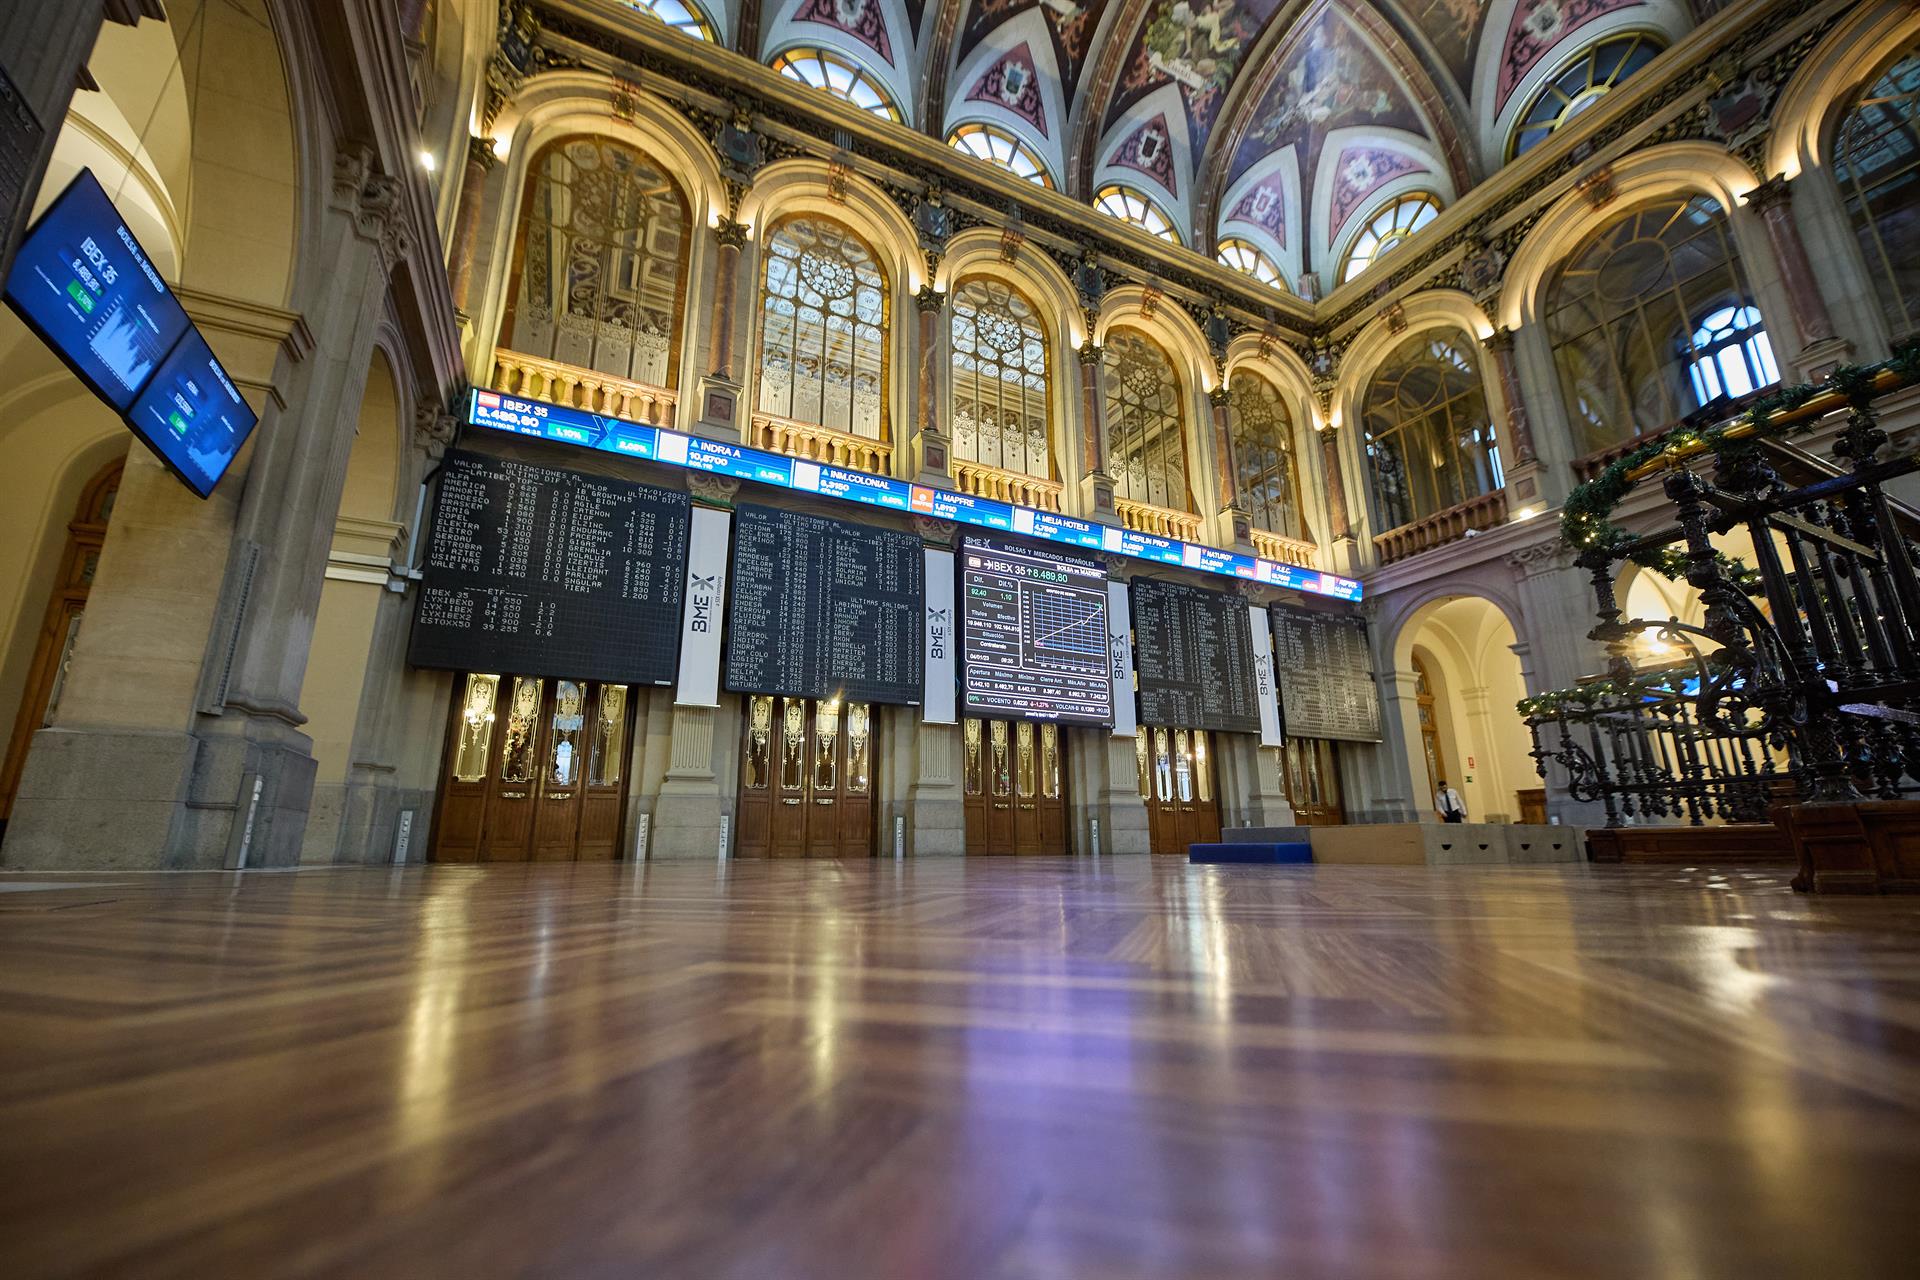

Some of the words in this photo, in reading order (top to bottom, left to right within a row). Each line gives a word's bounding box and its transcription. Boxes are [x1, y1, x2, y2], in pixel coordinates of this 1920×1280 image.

[80, 236, 108, 272] IBEX
[102, 265, 118, 285] 35
[504, 400, 531, 414] IBEX
[534, 406, 548, 417] 35
[477, 406, 539, 427] 8.489,80
[701, 442, 731, 456] INDRA
[733, 449, 741, 458] A
[445, 471, 469, 481] ALFA
[453, 459, 483, 470] VALOR
[506, 469, 539, 480] ULTIMO
[544, 476, 560, 484] DIF
[444, 478, 485, 490] AMERICA
[501, 461, 567, 478] COTIZACIONES
[638, 487, 686, 500] 04/01/2023
[831, 470, 890, 490] INM.COLONIAL
[443, 484, 484, 497] BANORTE
[582, 483, 607, 492] VALOR
[628, 491, 657, 501] ULTIMO
[442, 491, 489, 504] BRADESCO
[596, 498, 616, 506] BION
[943, 494, 975, 508] MAPFRE
[441, 498, 482, 510] BRASKEM
[574, 500, 600, 510] AGILE
[440, 505, 470, 515] CEMIG
[574, 506, 610, 518] CATENON
[438, 511, 469, 522] COPEL
[573, 513, 594, 521] EIDF
[745, 512, 767, 520] VALOR
[437, 518, 479, 530] ELEKTRA
[572, 519, 603, 529] ELZINC
[1042, 515, 1062, 526] MELIA
[1063, 520, 1089, 532] HOTELS
[436, 525, 472, 536] ELETRO
[571, 526, 613, 537] ENDURANC
[435, 532, 471, 543] GERDAU
[570, 532, 607, 543] FACEPHI
[570, 538, 596, 548] GIGAS
[965, 537, 981, 546] BME
[1129, 534, 1152, 545] MERLIN
[434, 539, 482, 551] PETROBRA
[569, 545, 611, 556] GRENALIA
[451, 548, 481, 558] AZTEC
[568, 551, 605, 562] HOLALUZ
[1004, 545, 1026, 553] BOLSAS
[1034, 550, 1063, 561] MERCADOS
[1066, 556, 1095, 567] ESPAÑOLES
[1207, 550, 1233, 561] NATURGY
[430, 560, 455, 569] VALE
[431, 553, 480, 565] USIMINAS
[567, 558, 604, 568] IZERTIS
[566, 564, 609, 575] LLEIDANT
[1015, 566, 1026, 575] 35
[1033, 568, 1068, 583] 8.489,80
[1057, 565, 1073, 573] BOLSA
[1080, 569, 1101, 578] MADRID
[566, 571, 598, 580] PARLEM
[565, 577, 602, 588] SNGULAR
[425, 588, 450, 597] IBEX
[564, 584, 591, 593] TIER1
[423, 603, 442, 611] LYX
[448, 605, 473, 614] IBEX
[983, 601, 1003, 609] Volumen
[692, 594, 709, 632] BME
[420, 617, 470, 628] ESTOXX50
[931, 626, 943, 658] BME
[980, 641, 1007, 649] Contratando
[1113, 650, 1124, 679] BME
